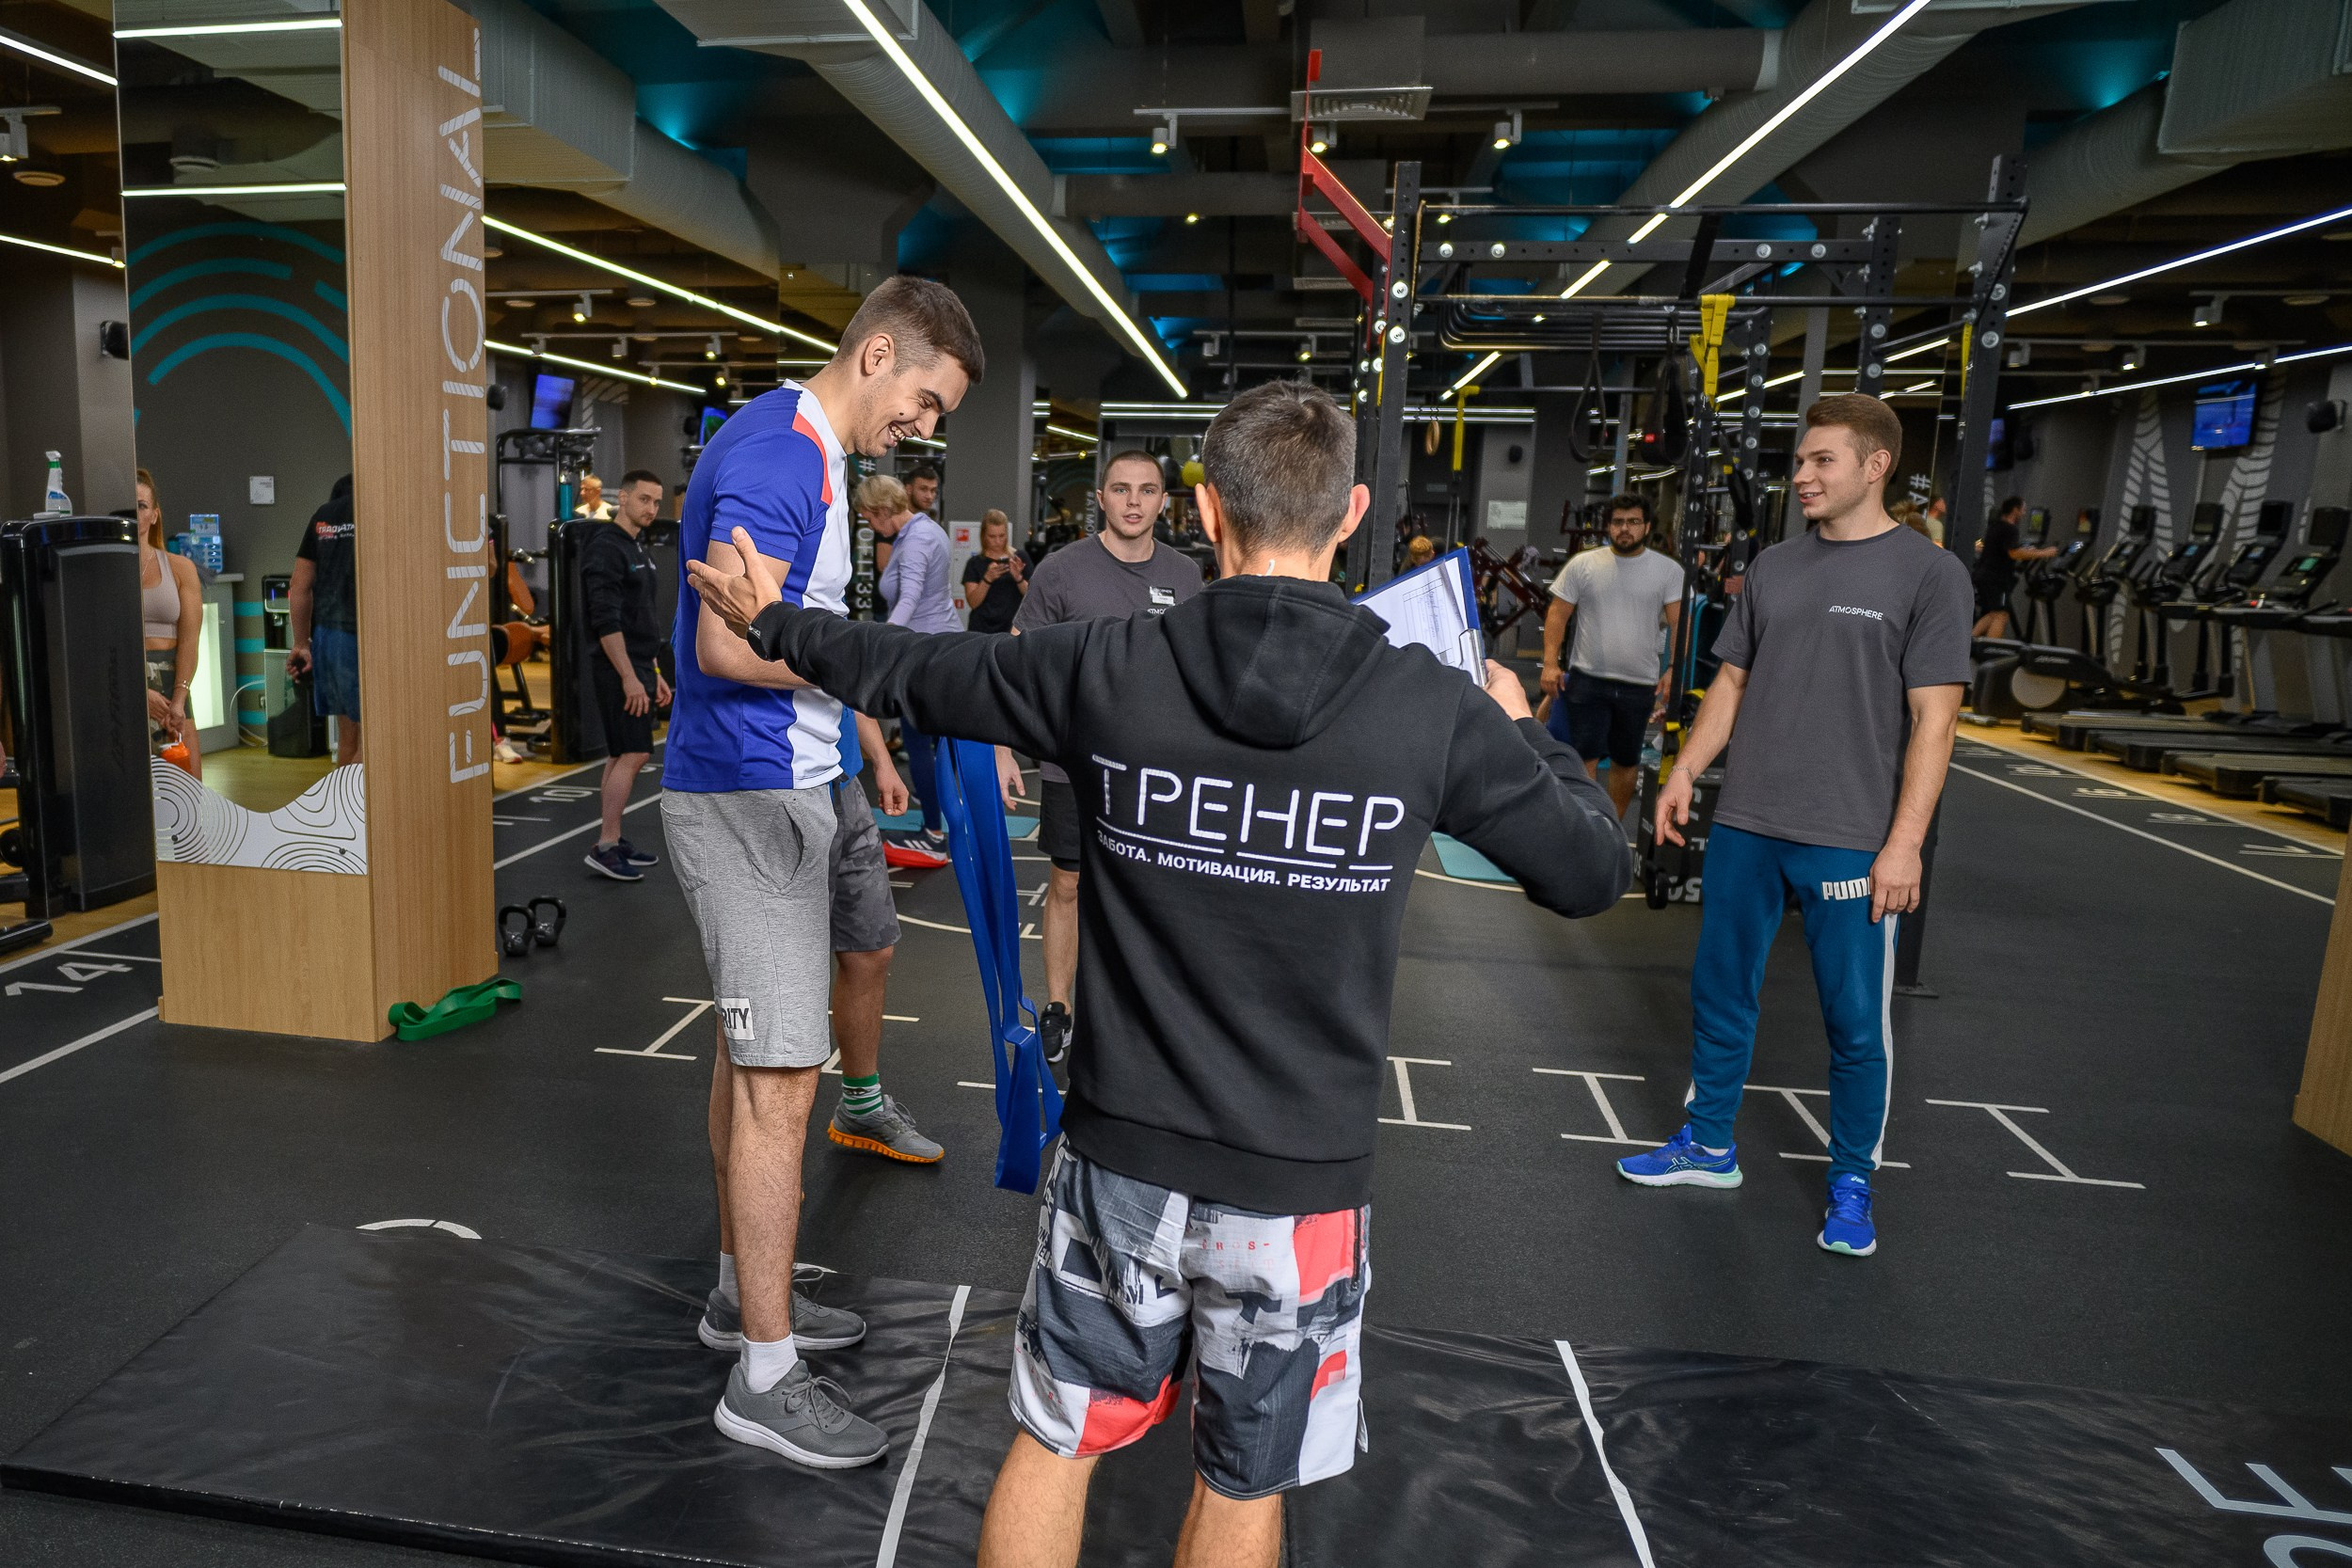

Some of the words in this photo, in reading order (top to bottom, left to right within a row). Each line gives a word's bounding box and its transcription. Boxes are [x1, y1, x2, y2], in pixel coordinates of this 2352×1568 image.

[437, 27, 490, 784] FUNCTIONAL
[1828, 605, 1883, 621] ATMOSPHERE
[529, 788, 594, 803] 10
[1092, 753, 1406, 857] ТРЕНЕР
[1097, 830, 1152, 863] ЗАБОТА.
[1157, 852, 1280, 884] МОТИВАЦИЯ.
[1287, 874, 1391, 893] РЕЗУЛЬТАТ
[5, 961, 134, 996] 14
